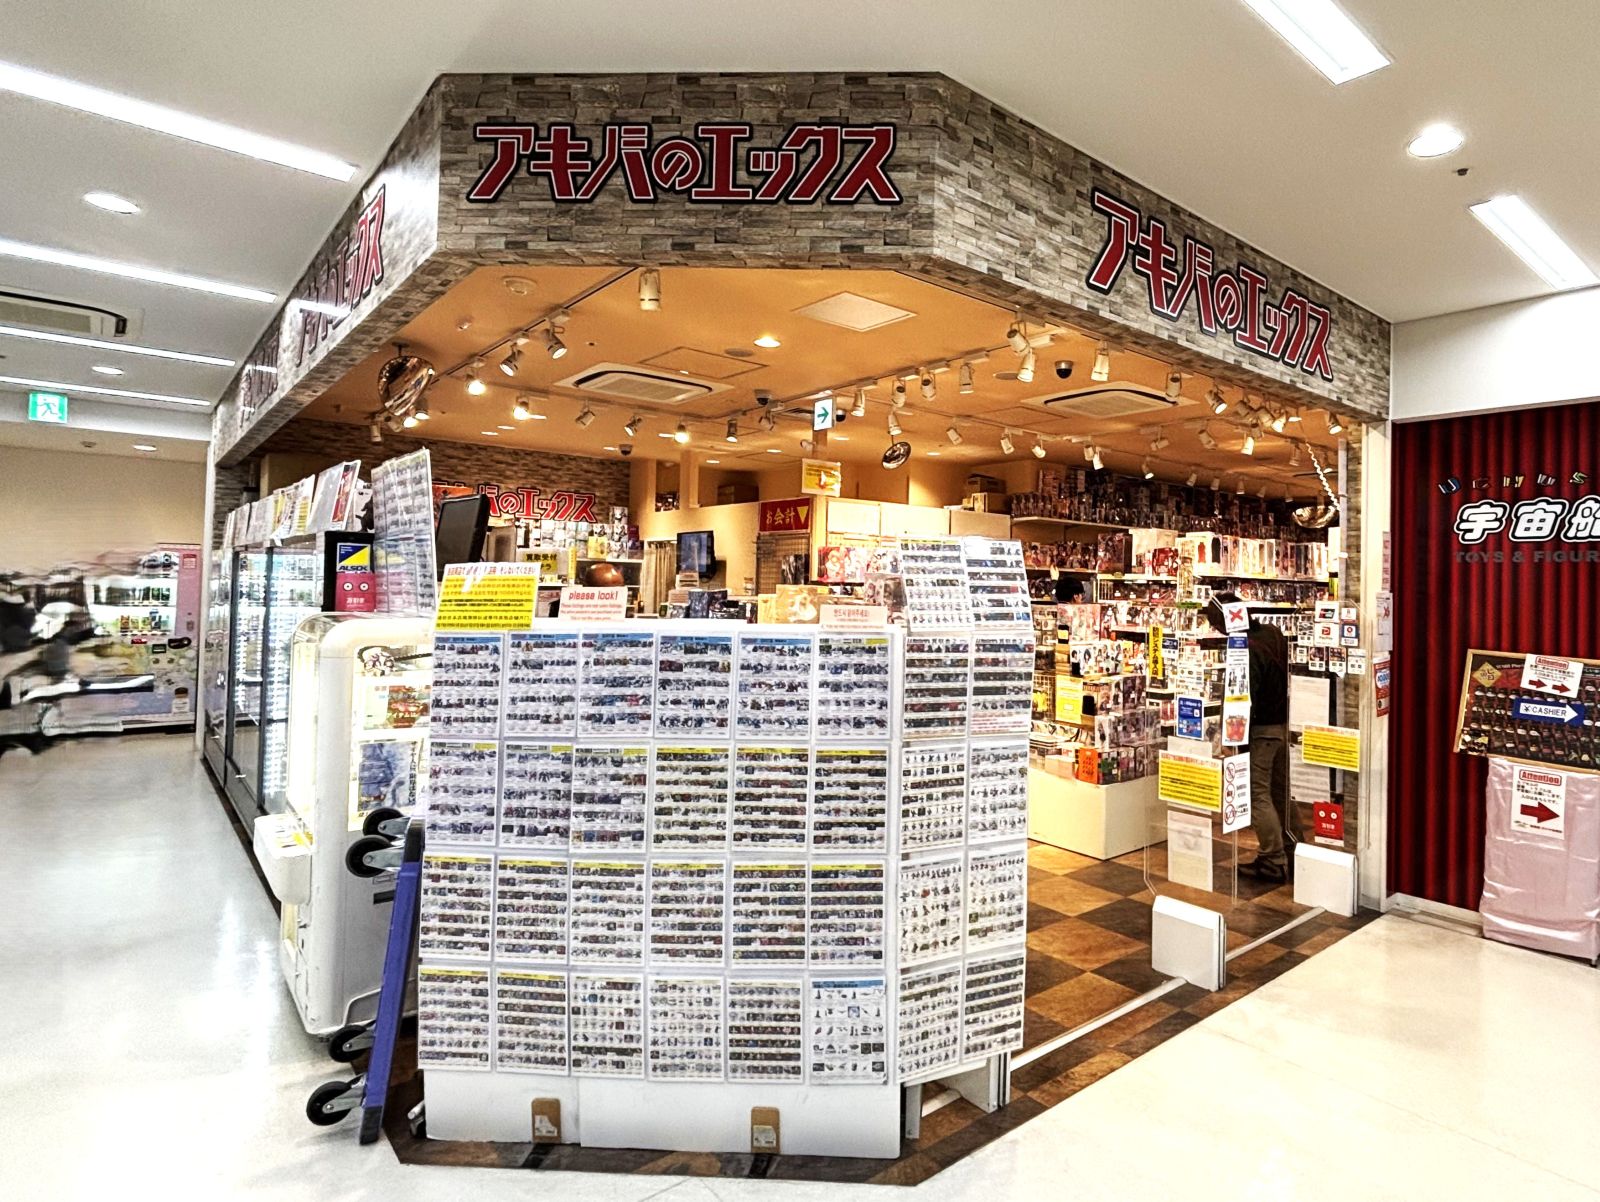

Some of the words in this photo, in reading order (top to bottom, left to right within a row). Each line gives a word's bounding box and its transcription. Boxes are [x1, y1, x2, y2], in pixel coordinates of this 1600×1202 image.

[468, 124, 902, 203] アキバのエックス
[1088, 191, 1333, 381] アキバのエックス
[766, 507, 796, 527] お会計
[1456, 551, 1504, 563] TOYS
[1512, 551, 1525, 563] &
[569, 591, 595, 600] please
[598, 590, 618, 600] look!
[1532, 705, 1567, 717] CASHIER
[1522, 771, 1560, 784] Attention
